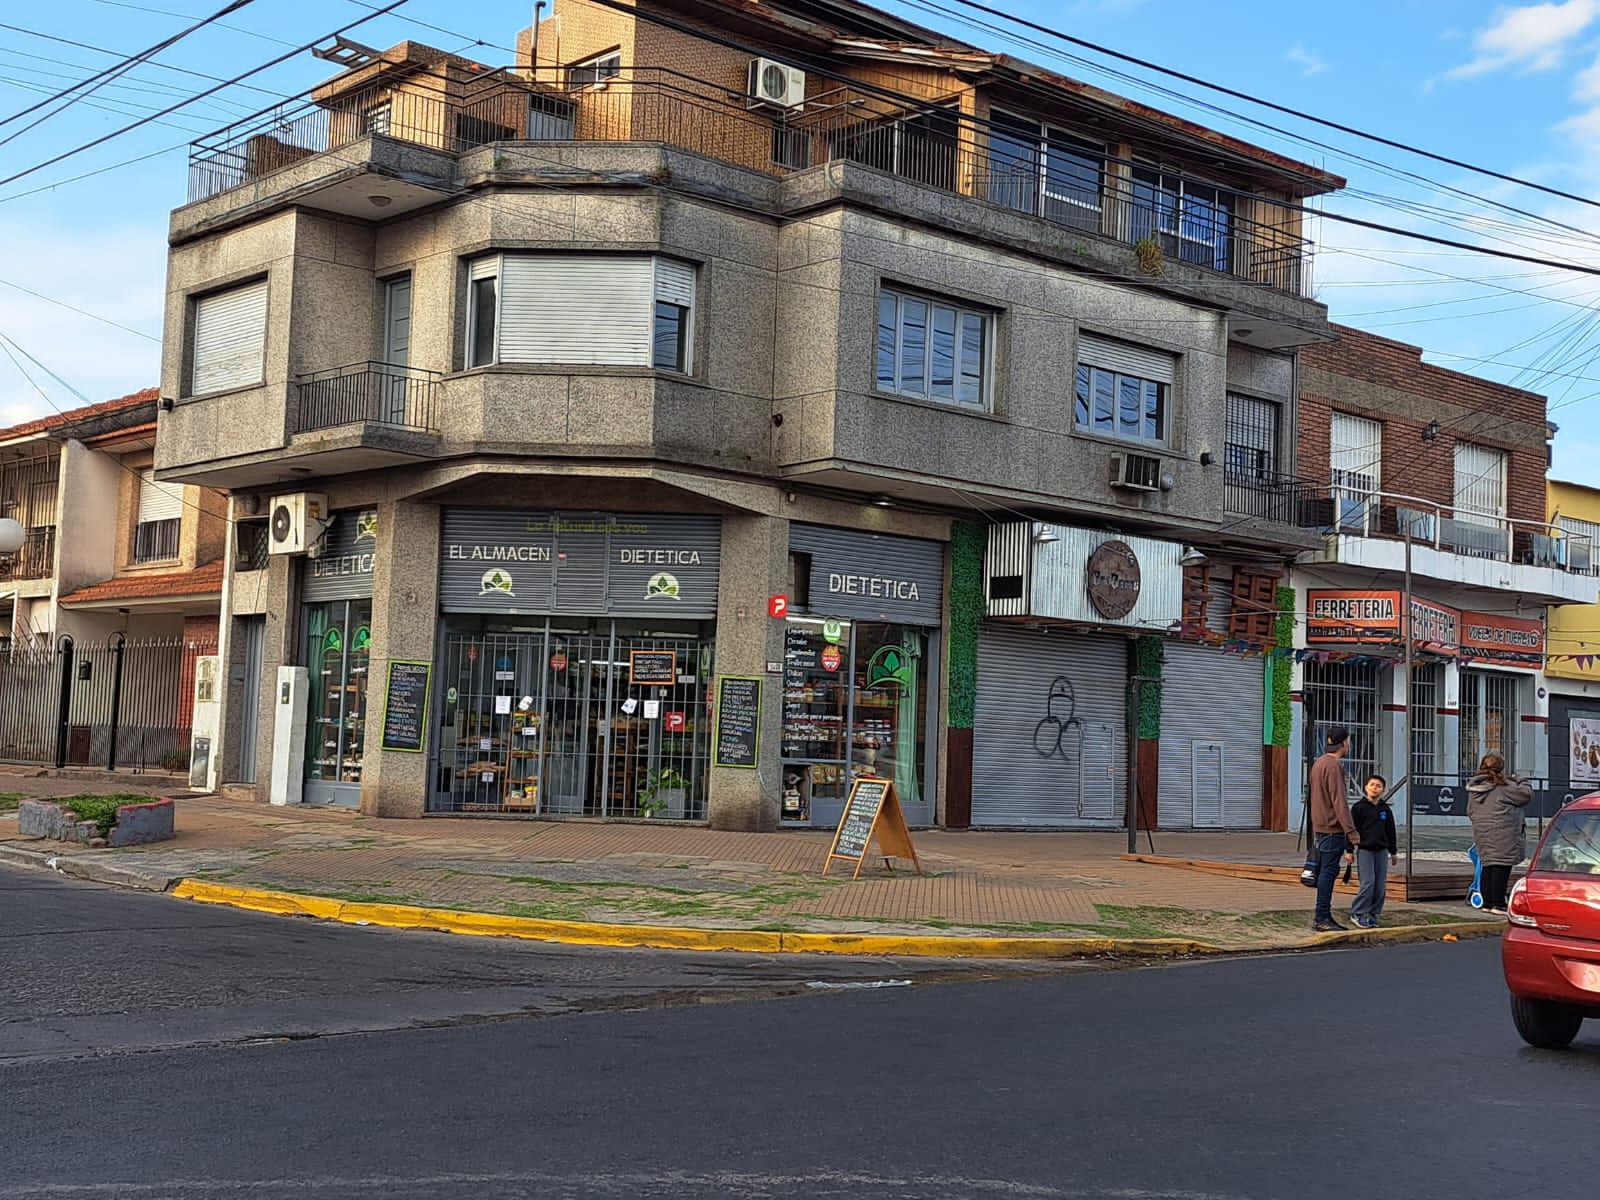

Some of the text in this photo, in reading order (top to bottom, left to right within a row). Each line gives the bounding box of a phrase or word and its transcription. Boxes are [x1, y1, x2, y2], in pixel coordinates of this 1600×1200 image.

[449, 544, 467, 559] EL
[829, 573, 919, 601] DIETÉTICA
[1314, 598, 1394, 620] FERRETERIA
